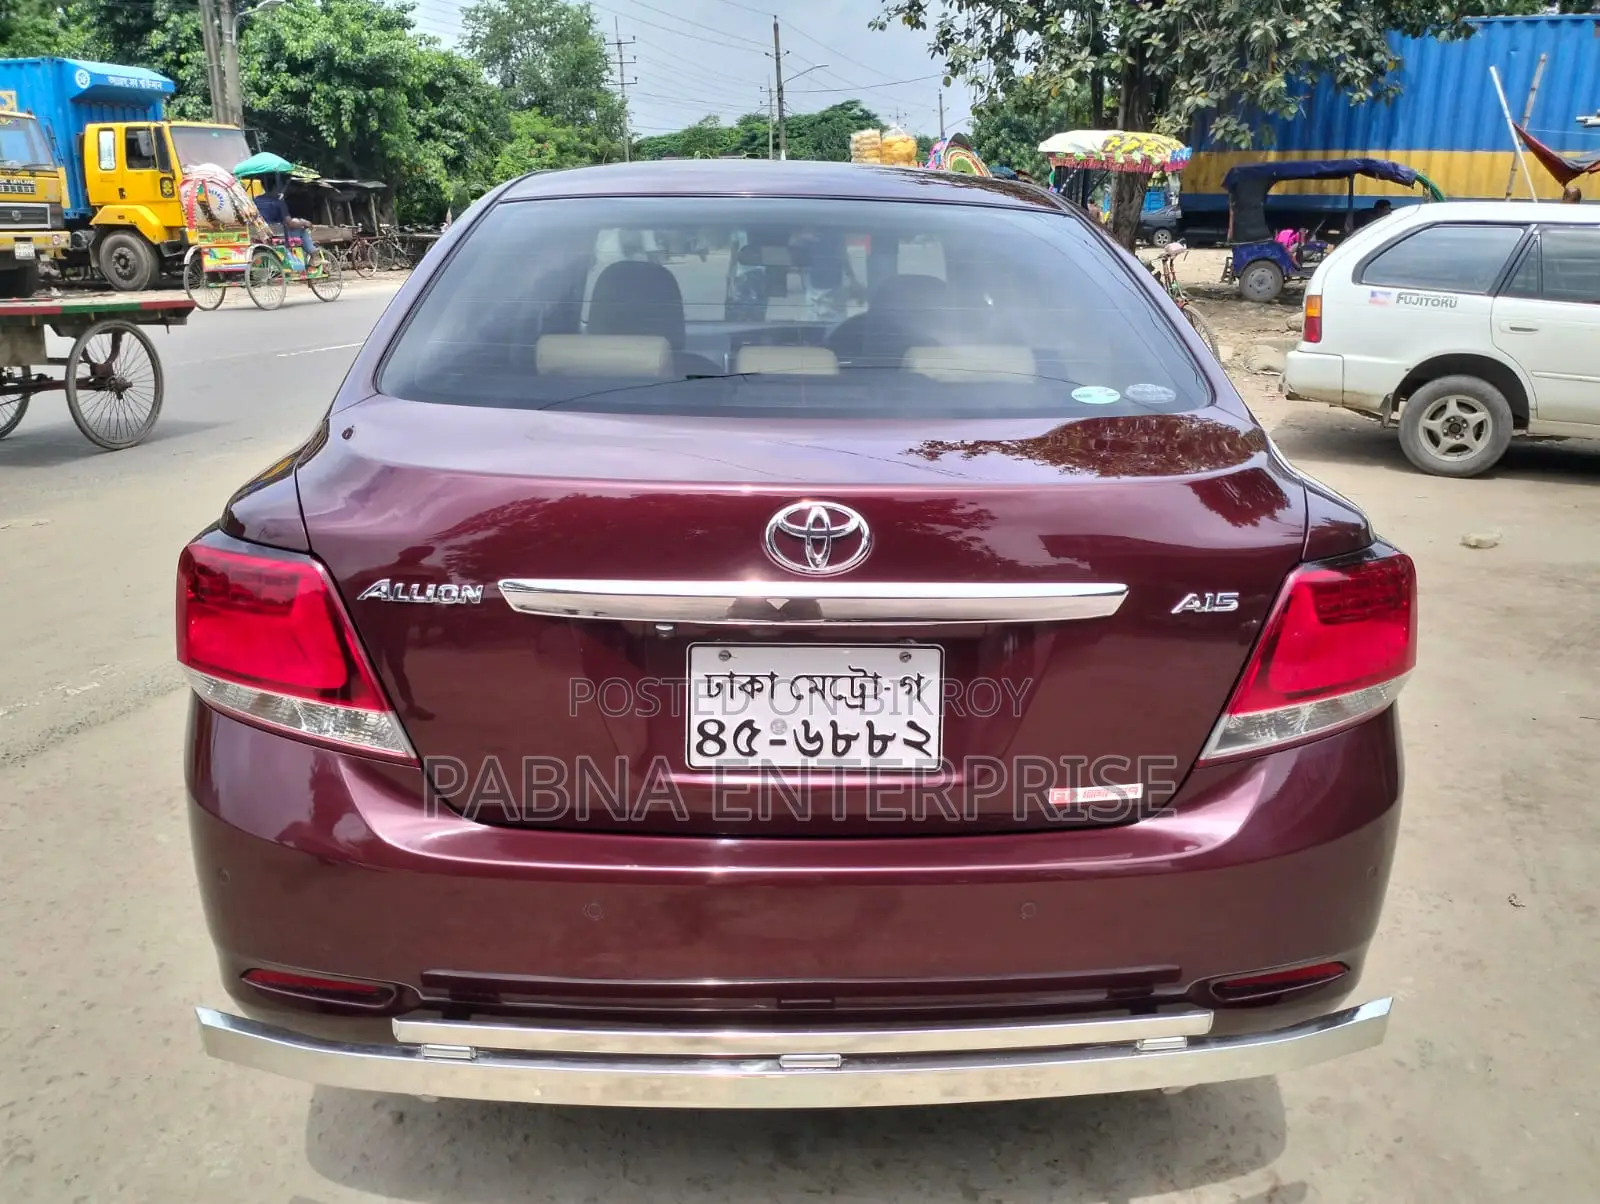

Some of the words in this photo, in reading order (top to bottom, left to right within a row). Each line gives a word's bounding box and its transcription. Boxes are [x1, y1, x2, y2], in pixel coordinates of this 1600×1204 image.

[1396, 292, 1458, 308] FUJITOKU
[356, 578, 484, 604] ALLION
[1170, 592, 1239, 614] A15
[704, 671, 779, 700] ঢাকা
[695, 718, 933, 758] ৪৫-৬৮৮২
